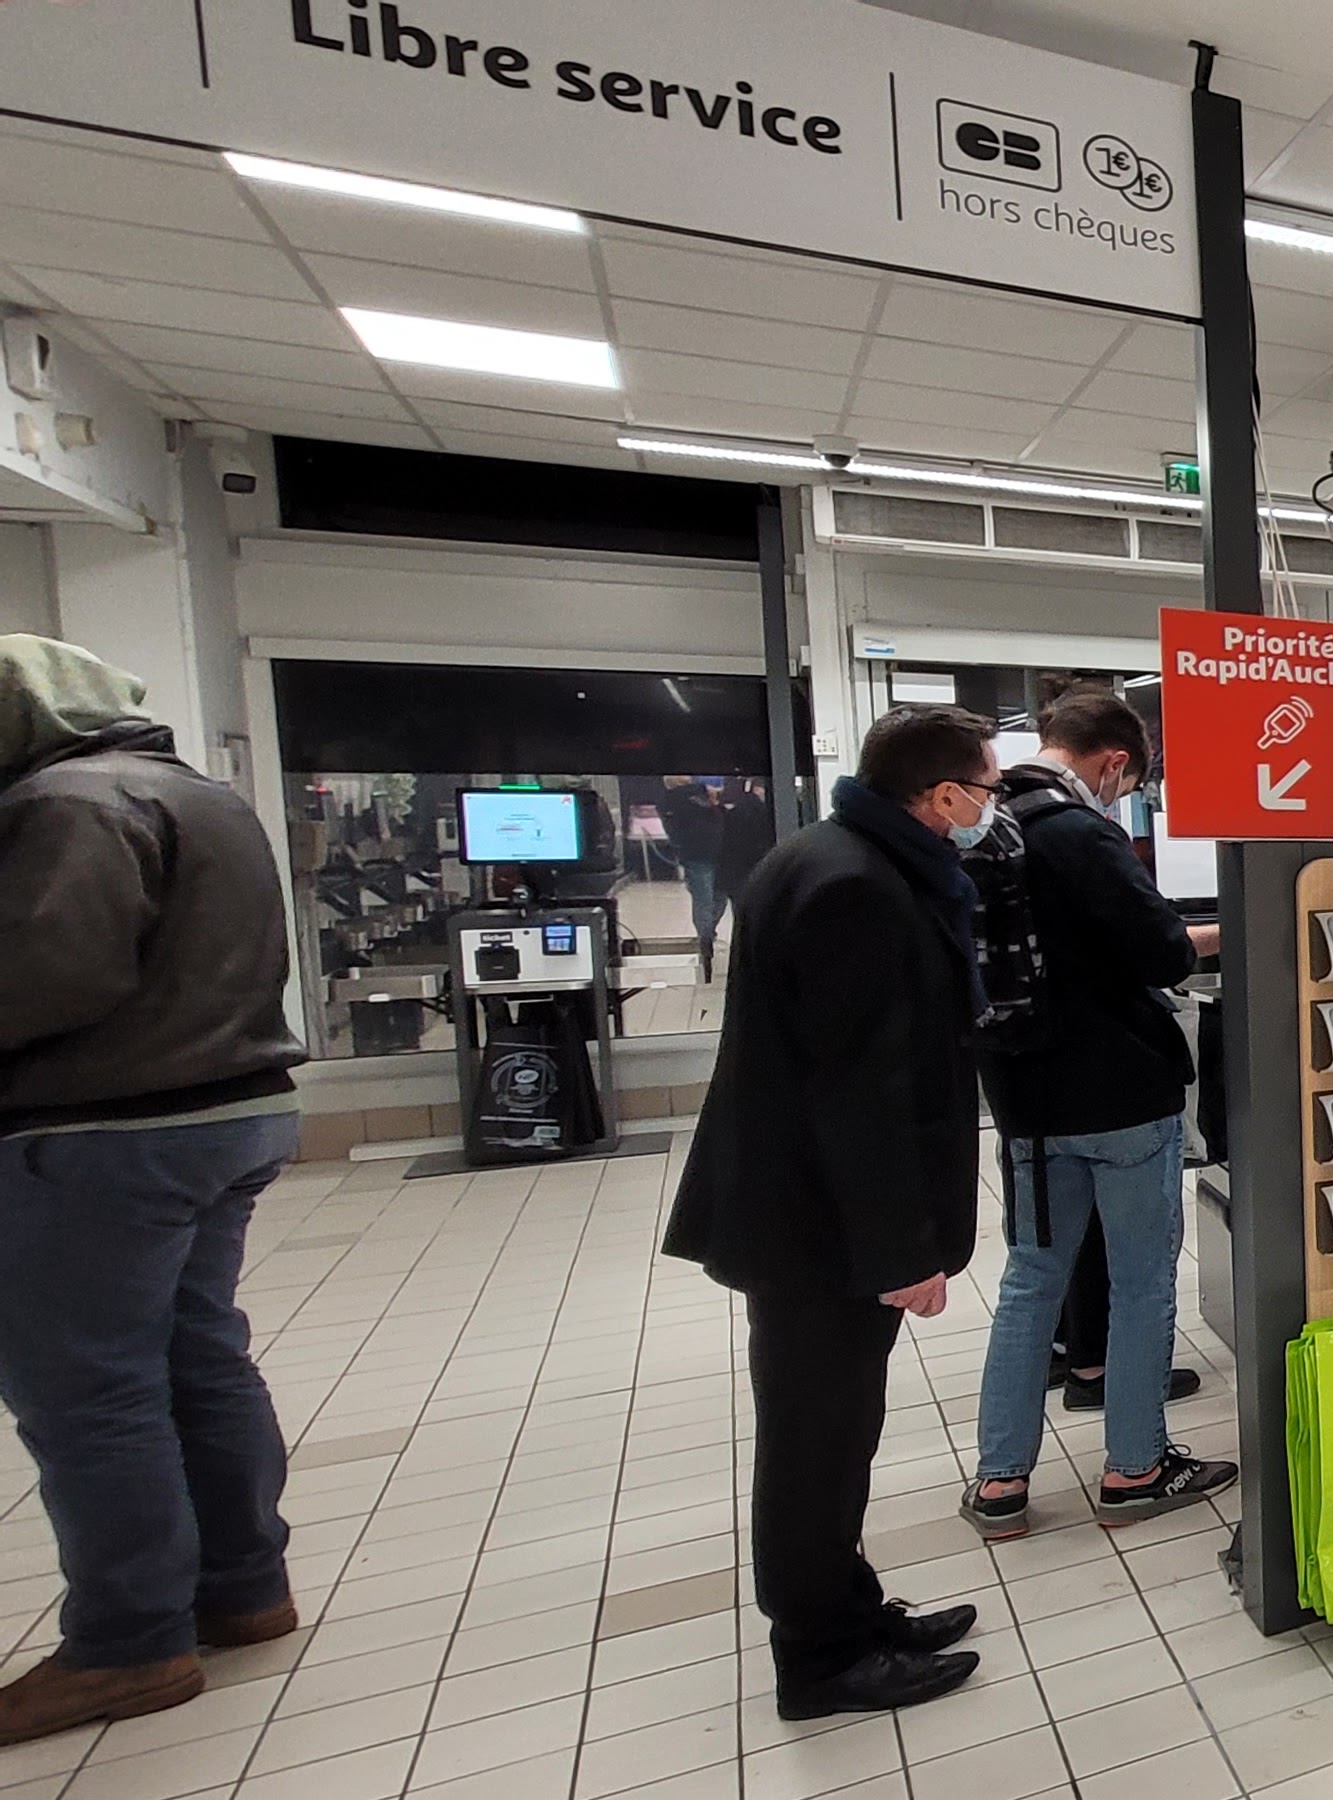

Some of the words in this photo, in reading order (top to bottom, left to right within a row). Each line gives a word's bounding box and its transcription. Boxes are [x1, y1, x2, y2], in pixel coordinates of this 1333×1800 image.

[290, 0, 532, 89] Libre
[556, 60, 844, 155] service
[939, 179, 1021, 223] hors
[1034, 202, 1175, 254] chèques
